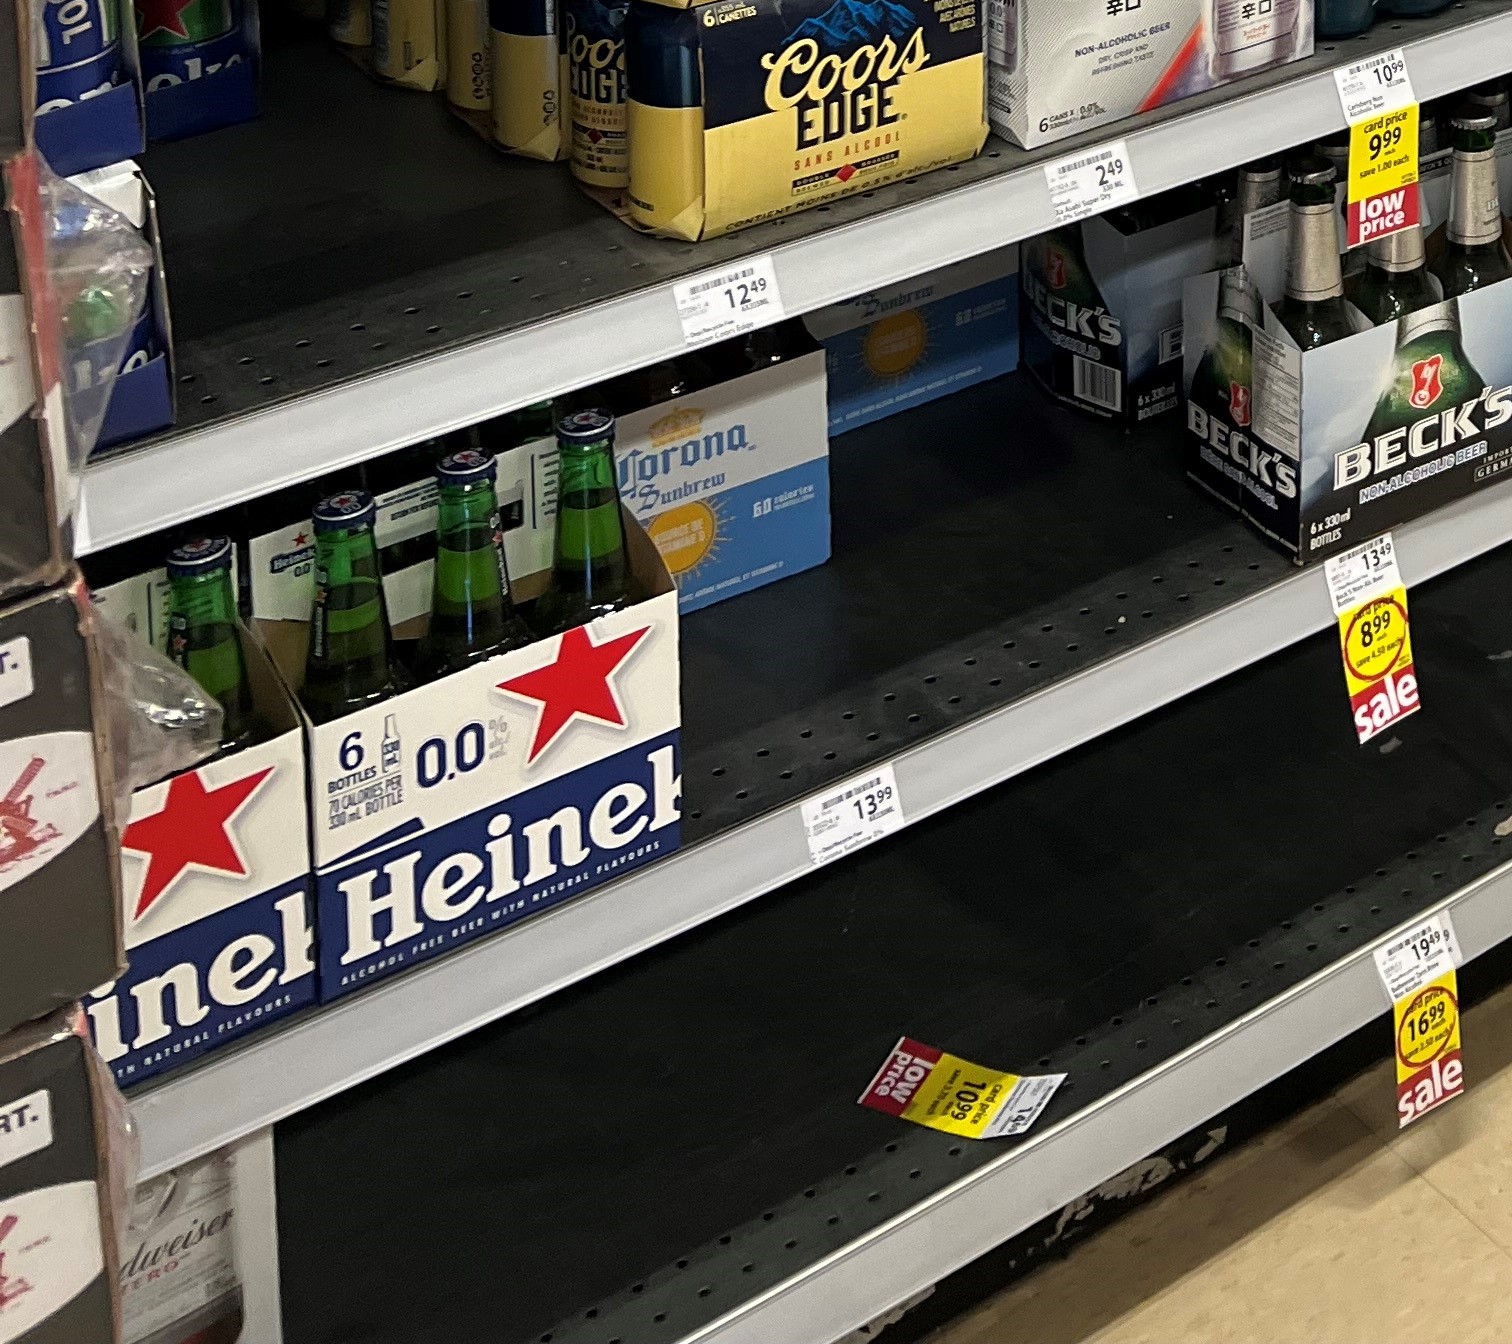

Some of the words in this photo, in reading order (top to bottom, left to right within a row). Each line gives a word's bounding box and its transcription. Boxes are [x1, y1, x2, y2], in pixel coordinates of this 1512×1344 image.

[760, 23, 931, 114] Coors
[794, 73, 903, 153] EDGE
[1363, 116, 1384, 134] card
[793, 148, 834, 172] SANS
[844, 129, 902, 159] ALCOOL
[1358, 189, 1406, 223] low
[637, 471, 727, 513] Sunbrew
[1358, 453, 1456, 505] NON-ALCOHOLIC
[1353, 671, 1420, 745] sale
[327, 764, 378, 795] BOTTLES
[338, 730, 365, 772] 6
[415, 719, 487, 790] 0.0
[340, 952, 404, 987] ALCOHOL
[411, 933, 444, 956] FREE
[451, 917, 485, 938] BEER
[490, 899, 526, 921] WITH
[532, 870, 589, 903] NATURAL
[595, 840, 661, 876] FLAVOURS
[143, 1031, 210, 1067] NATURAL
[217, 994, 292, 1035] FLAVOURS
[1397, 1055, 1465, 1125] sale
